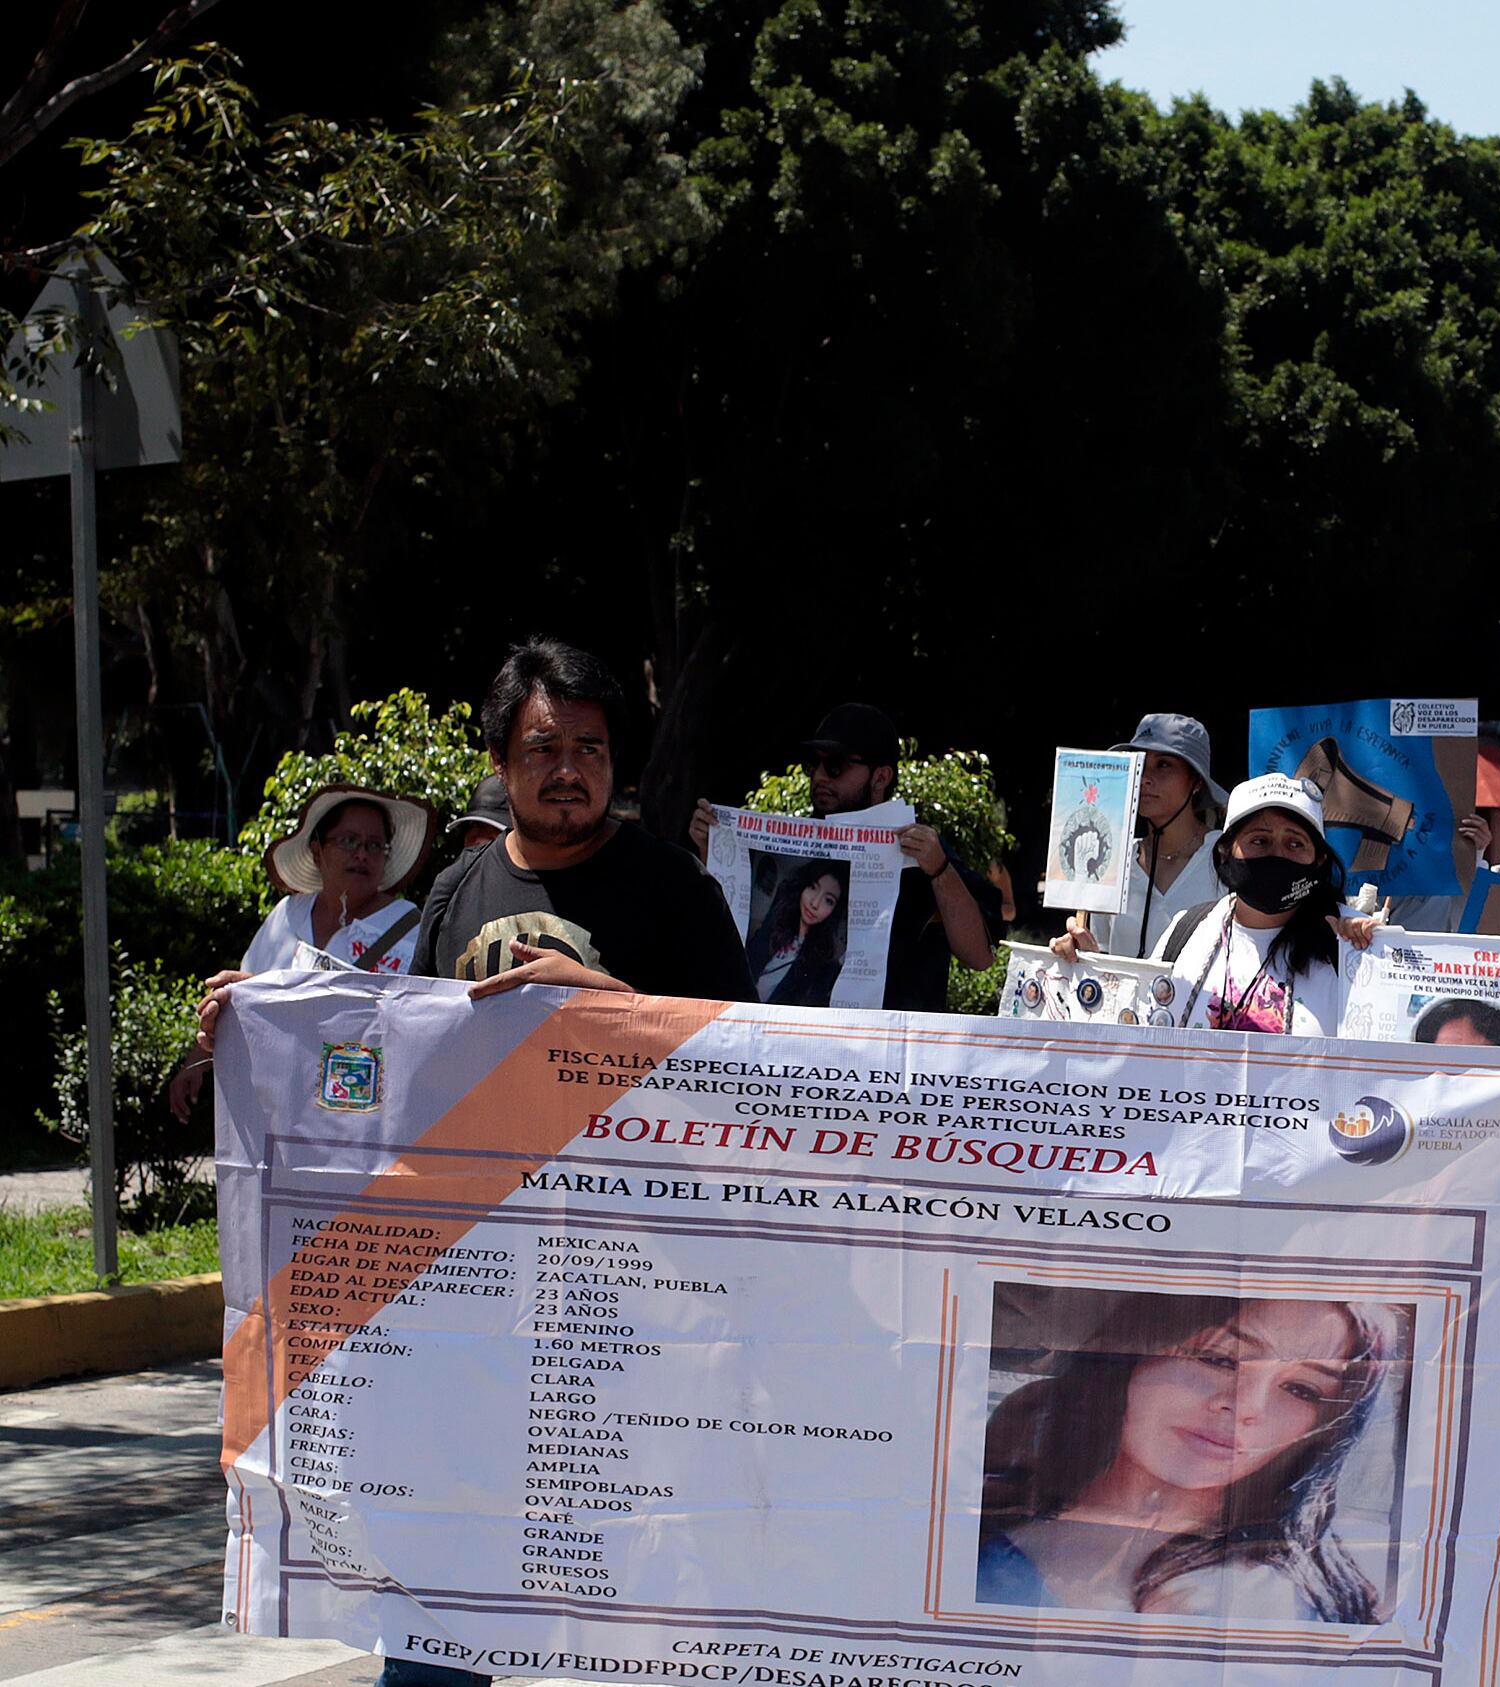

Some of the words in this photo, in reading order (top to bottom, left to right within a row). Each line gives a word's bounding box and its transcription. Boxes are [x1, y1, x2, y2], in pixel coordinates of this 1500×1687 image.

[737, 815, 763, 832] NADIA
[766, 820, 813, 838] GUADALUPE
[817, 824, 854, 842] MORALES
[856, 828, 895, 844] ROSALES
[1414, 984, 1424, 992] EN
[1434, 987, 1472, 996] MUNICIPIO
[548, 1048, 657, 1070] FISCALÍA
[666, 1058, 860, 1083] ESPECIALIZADA
[869, 1070, 901, 1084] EN
[911, 1072, 1108, 1098] INVESTIGACION
[1118, 1086, 1152, 1101] DE
[1160, 1089, 1207, 1105] LOS
[1215, 1092, 1321, 1112] DELITOS
[558, 1069, 589, 1084] DE
[598, 1071, 782, 1098] DESAPARICION
[792, 1085, 909, 1105] FORZADA
[920, 1093, 954, 1108] DE
[963, 1094, 1091, 1118] PERSONAS
[1101, 1105, 1114, 1118] Y
[1122, 1106, 1309, 1131] DESAPARICION
[736, 1102, 870, 1123] COMETIDA
[879, 1111, 928, 1126] POR
[936, 1114, 1126, 1140] PARTICULARES
[1419, 1116, 1472, 1128] FISCALÍA
[583, 1114, 796, 1152] BOLETÍN
[809, 1129, 878, 1157] DE
[891, 1131, 1159, 1177] BÚSQUEDA
[1418, 1141, 1462, 1151] PUEBLA
[520, 1171, 632, 1197] MARIA
[644, 1178, 709, 1202] DEL
[722, 1184, 819, 1209] PILAR
[833, 1192, 1001, 1222] ALARCÓN
[1013, 1204, 1172, 1234] VELASCO
[292, 1217, 441, 1240] NACIONALIDAD:
[291, 1235, 349, 1250] FECHA
[356, 1241, 380, 1254] DE
[384, 1244, 516, 1262] NACIMIENTO:
[538, 1236, 640, 1253] MEXICANA
[290, 1252, 350, 1268] LUGAR
[356, 1258, 380, 1271] DE
[386, 1260, 516, 1280] NACIMIENTO:
[537, 1254, 654, 1272] 20/09/1999
[290, 1270, 340, 1284] EDAD
[344, 1275, 367, 1286] AL
[372, 1277, 514, 1298] DESAPARECER:
[536, 1272, 648, 1290] ZACATLAN,
[654, 1279, 728, 1295] PUEBLA
[290, 1285, 340, 1299] EDAD
[344, 1290, 426, 1306] ACTUAL:
[536, 1289, 559, 1301] 23
[565, 1288, 620, 1303] AÑOS
[288, 1302, 342, 1317] SEXO:
[534, 1304, 558, 1316] 23
[564, 1303, 618, 1319] AÑOS
[287, 1319, 390, 1337] ESTATURA:
[534, 1321, 635, 1338] FEMENINO
[287, 1336, 413, 1357] COMPLEXIÓN:
[534, 1338, 574, 1352] 1.60
[581, 1341, 662, 1356] METROS
[288, 1354, 326, 1368] TEZ:
[532, 1355, 625, 1372] DELGADA
[288, 1370, 374, 1388] CABELLO:
[530, 1372, 596, 1388] CLARA
[288, 1388, 353, 1405] COLOR:
[530, 1390, 596, 1406] LARGO
[288, 1404, 338, 1421] CARA:
[289, 1422, 355, 1440] OREJAS:
[528, 1408, 596, 1423] NEGRO
[602, 1412, 690, 1429] /TEÑIDO
[696, 1418, 722, 1431] DE
[729, 1420, 796, 1436] COLOR
[803, 1424, 894, 1443] MORADO
[528, 1426, 624, 1442] OVALADA
[290, 1440, 356, 1458] FRENTE:
[527, 1443, 630, 1460] MEDIANAS
[290, 1456, 338, 1474] CEJAS:
[526, 1461, 601, 1476] AMPLIA
[290, 1473, 327, 1488] TIPO
[332, 1480, 354, 1493] DE
[360, 1482, 414, 1498] OJOS:
[525, 1478, 674, 1498] SEMIPOBLADAS
[300, 1500, 342, 1524] NARIZ:
[525, 1495, 633, 1513] OVALADOS
[524, 1510, 574, 1526] CAFÉ
[524, 1527, 604, 1545] GRANDE
[522, 1544, 603, 1562] GRANDE
[521, 1562, 610, 1580] GRUESOS
[521, 1579, 618, 1598] OVALADO
[672, 1640, 782, 1659] CARPETA
[790, 1648, 824, 1663] DE
[830, 1651, 1022, 1678] INVESTIGACIÓN
